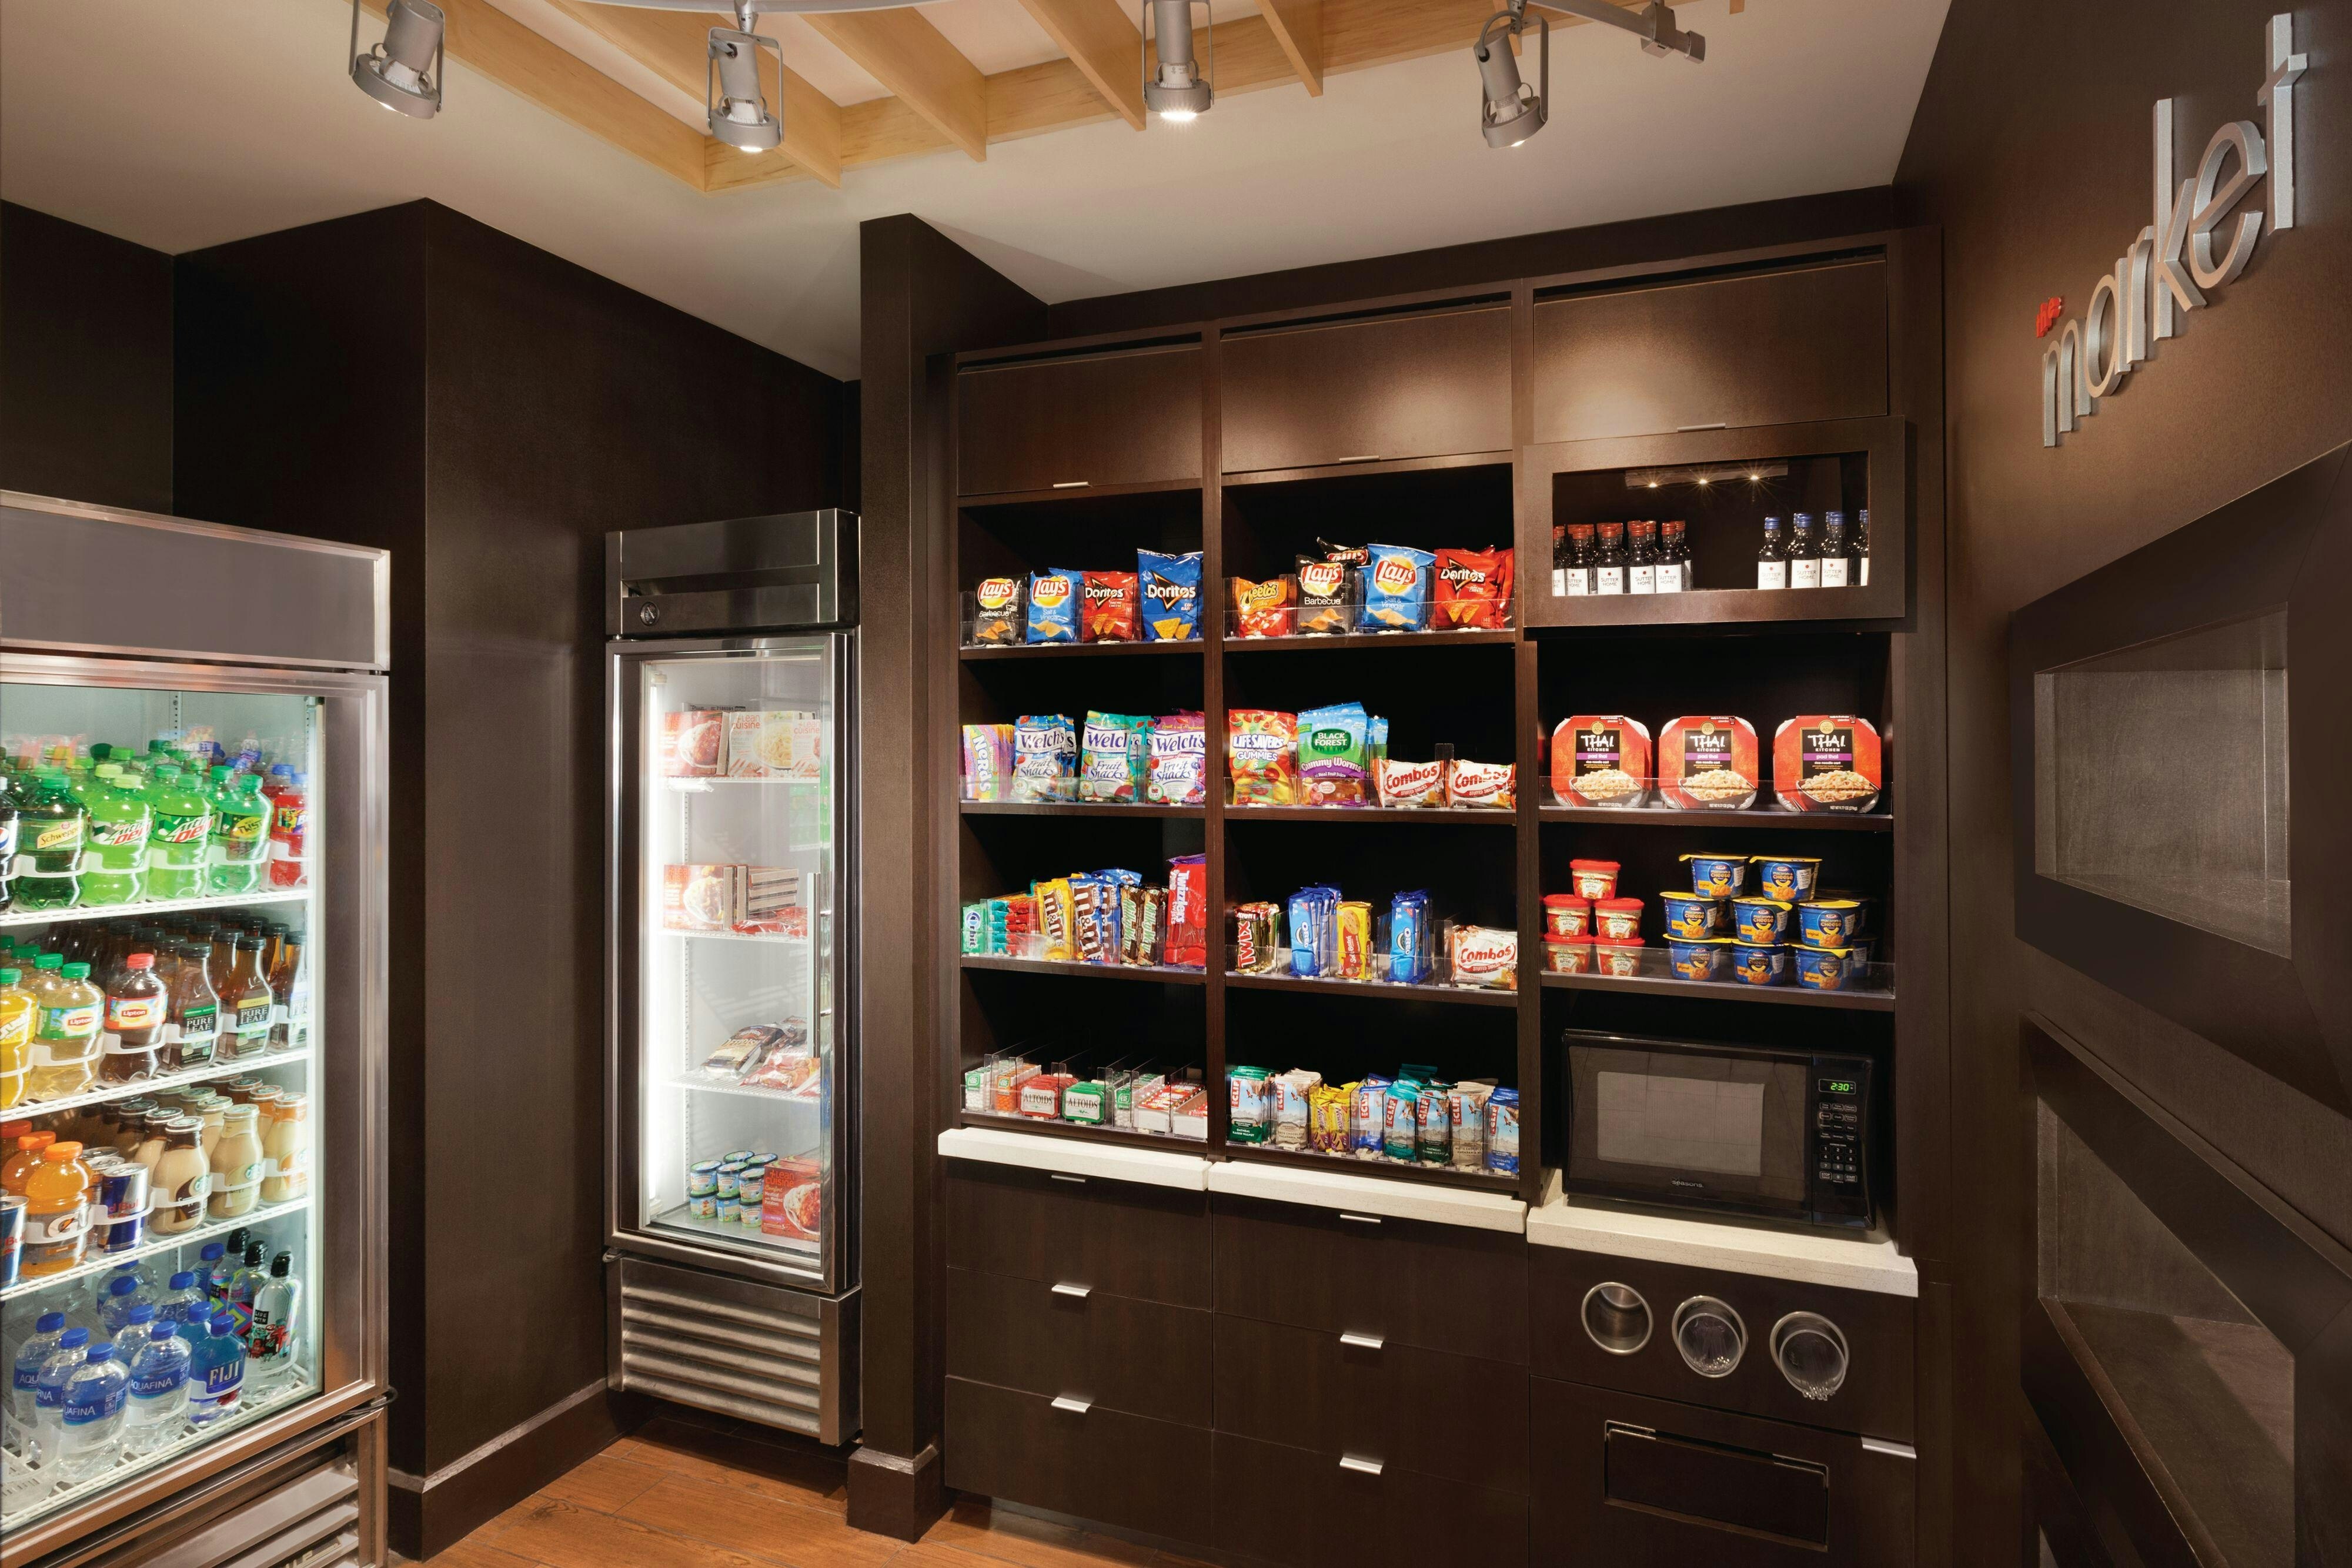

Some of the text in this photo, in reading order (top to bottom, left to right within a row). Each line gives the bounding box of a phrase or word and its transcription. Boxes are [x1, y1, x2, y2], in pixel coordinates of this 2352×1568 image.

[2042, 13, 2307, 447] market
[2036, 297, 2063, 337] the
[1305, 565, 1340, 586] Lay's
[1378, 561, 1415, 585] Lay's
[1441, 568, 1485, 583] Doritos
[980, 580, 1011, 599] Lay's
[1034, 580, 1067, 597] Lay's
[1085, 587, 1124, 598] Doritos
[1148, 584, 1196, 598] Doritos
[1241, 583, 1278, 607] Cheetos
[1382, 601, 1405, 611] Vinegar
[1155, 734, 1204, 752] Welch's
[1581, 735, 1614, 748] THAI
[1689, 735, 1725, 748] THAI
[1808, 734, 1846, 748] THAI
[1236, 751, 1278, 761] GUMMIES
[1096, 761, 1121, 770] Fruit
[1301, 757, 1362, 772] Gummy Worms
[1089, 768, 1124, 780] Snacks
[1155, 770, 1192, 783] Snacks
[1387, 765, 1438, 790] Combos
[1455, 768, 1508, 788] Combos
[1415, 784, 1428, 793] SNACKS
[1176, 870, 1190, 923] Twizzlers
[1302, 922, 1312, 948] OREO
[1404, 927, 1412, 955] OREO
[1238, 921, 1256, 969] TWIX
[1461, 946, 1511, 963] Combos
[240, 1008, 268, 1018] PURE
[240, 1015, 265, 1025] LEAF
[70, 1017, 93, 1025] Lipton
[187, 1017, 213, 1027] PURE
[186, 1024, 211, 1033] LEAF
[1830, 1082, 1850, 1091] 2:30
[1024, 1094, 1053, 1105] ALTOIDS
[1067, 1098, 1098, 1109] ALTOIDS
[1388, 1099, 1397, 1119] CLIF
[1419, 1099, 1429, 1118] CLIF
[1452, 1097, 1461, 1118] CLIF
[776, 1171, 794, 1180] Lean
[209, 1361, 240, 1385] FIJI
[131, 1377, 173, 1389] AQUAFINA
